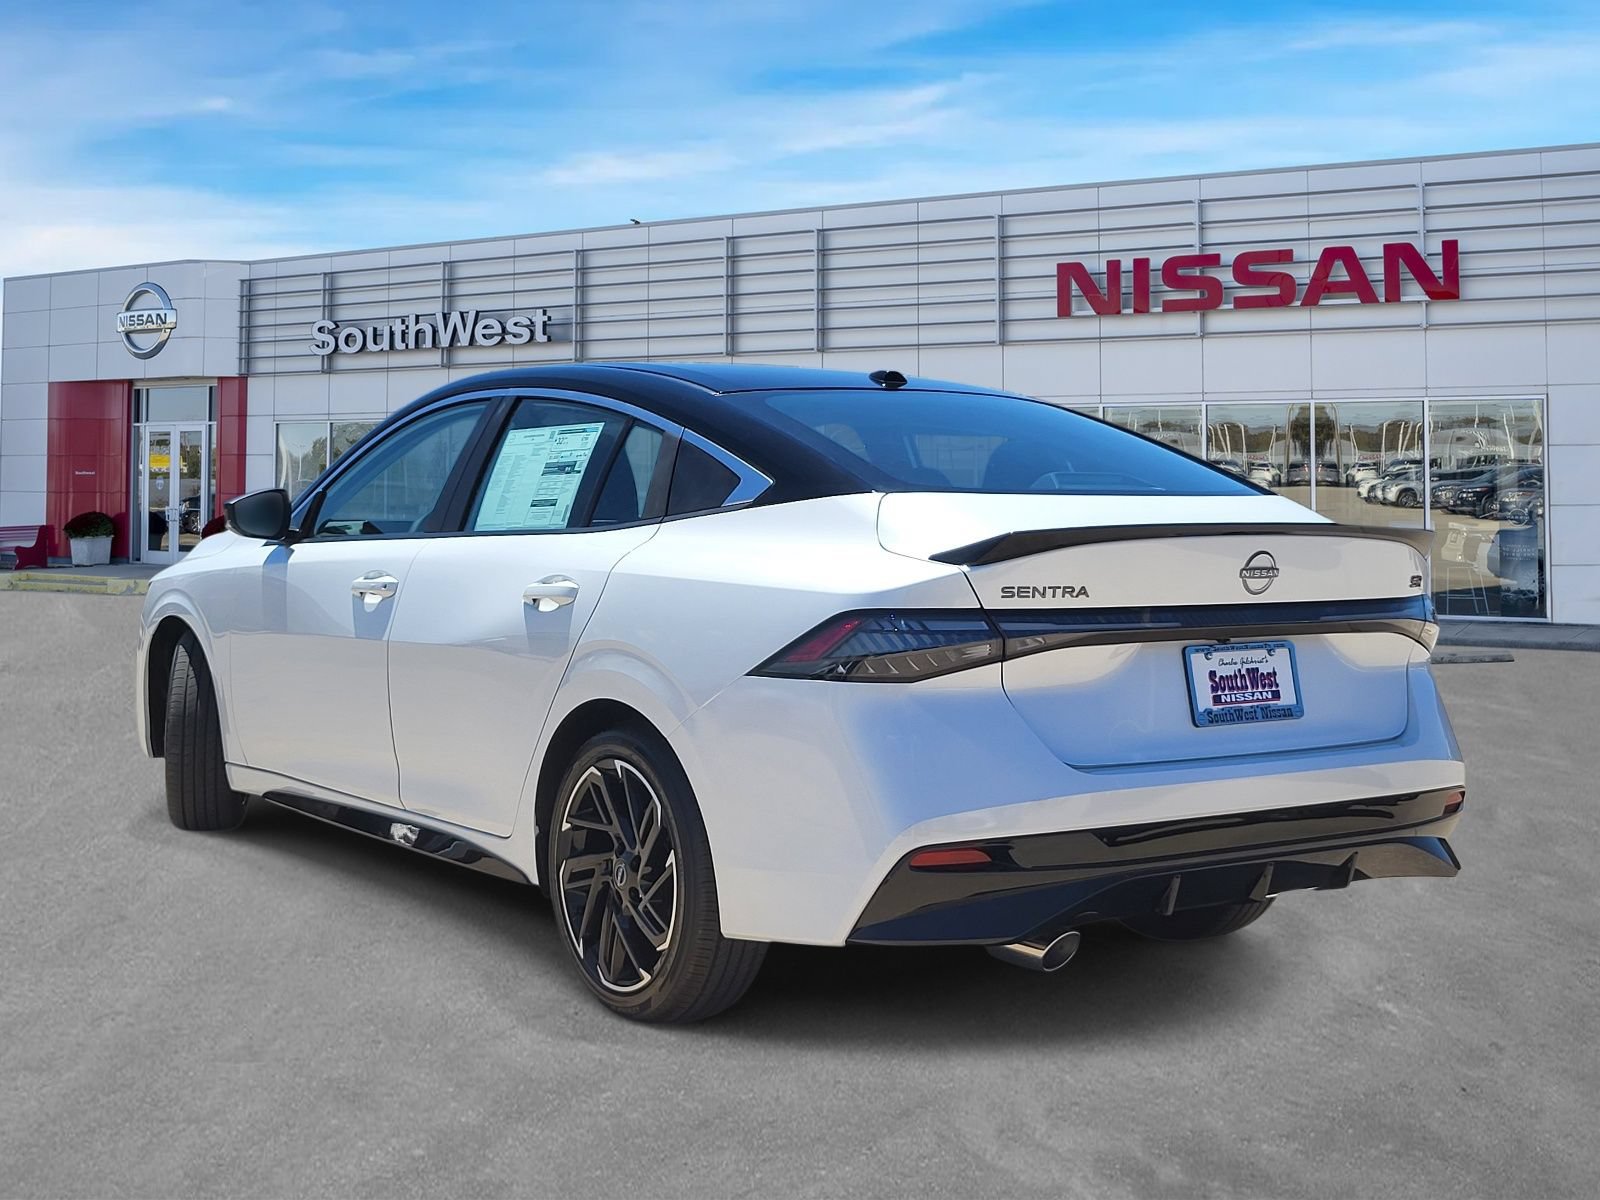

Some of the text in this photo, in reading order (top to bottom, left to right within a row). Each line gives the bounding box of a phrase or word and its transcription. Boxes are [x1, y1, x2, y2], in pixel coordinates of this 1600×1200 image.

[1057, 239, 1461, 318] NISSAN
[118, 312, 168, 329] NISSAN
[309, 308, 552, 356] SouthWest
[1241, 569, 1279, 577] NISSAN
[1000, 585, 1090, 599] SENTRA
[1208, 666, 1280, 694] SouthWest
[1221, 690, 1273, 703] NISSAN
[1206, 705, 1294, 724] SouthWest Nissan
